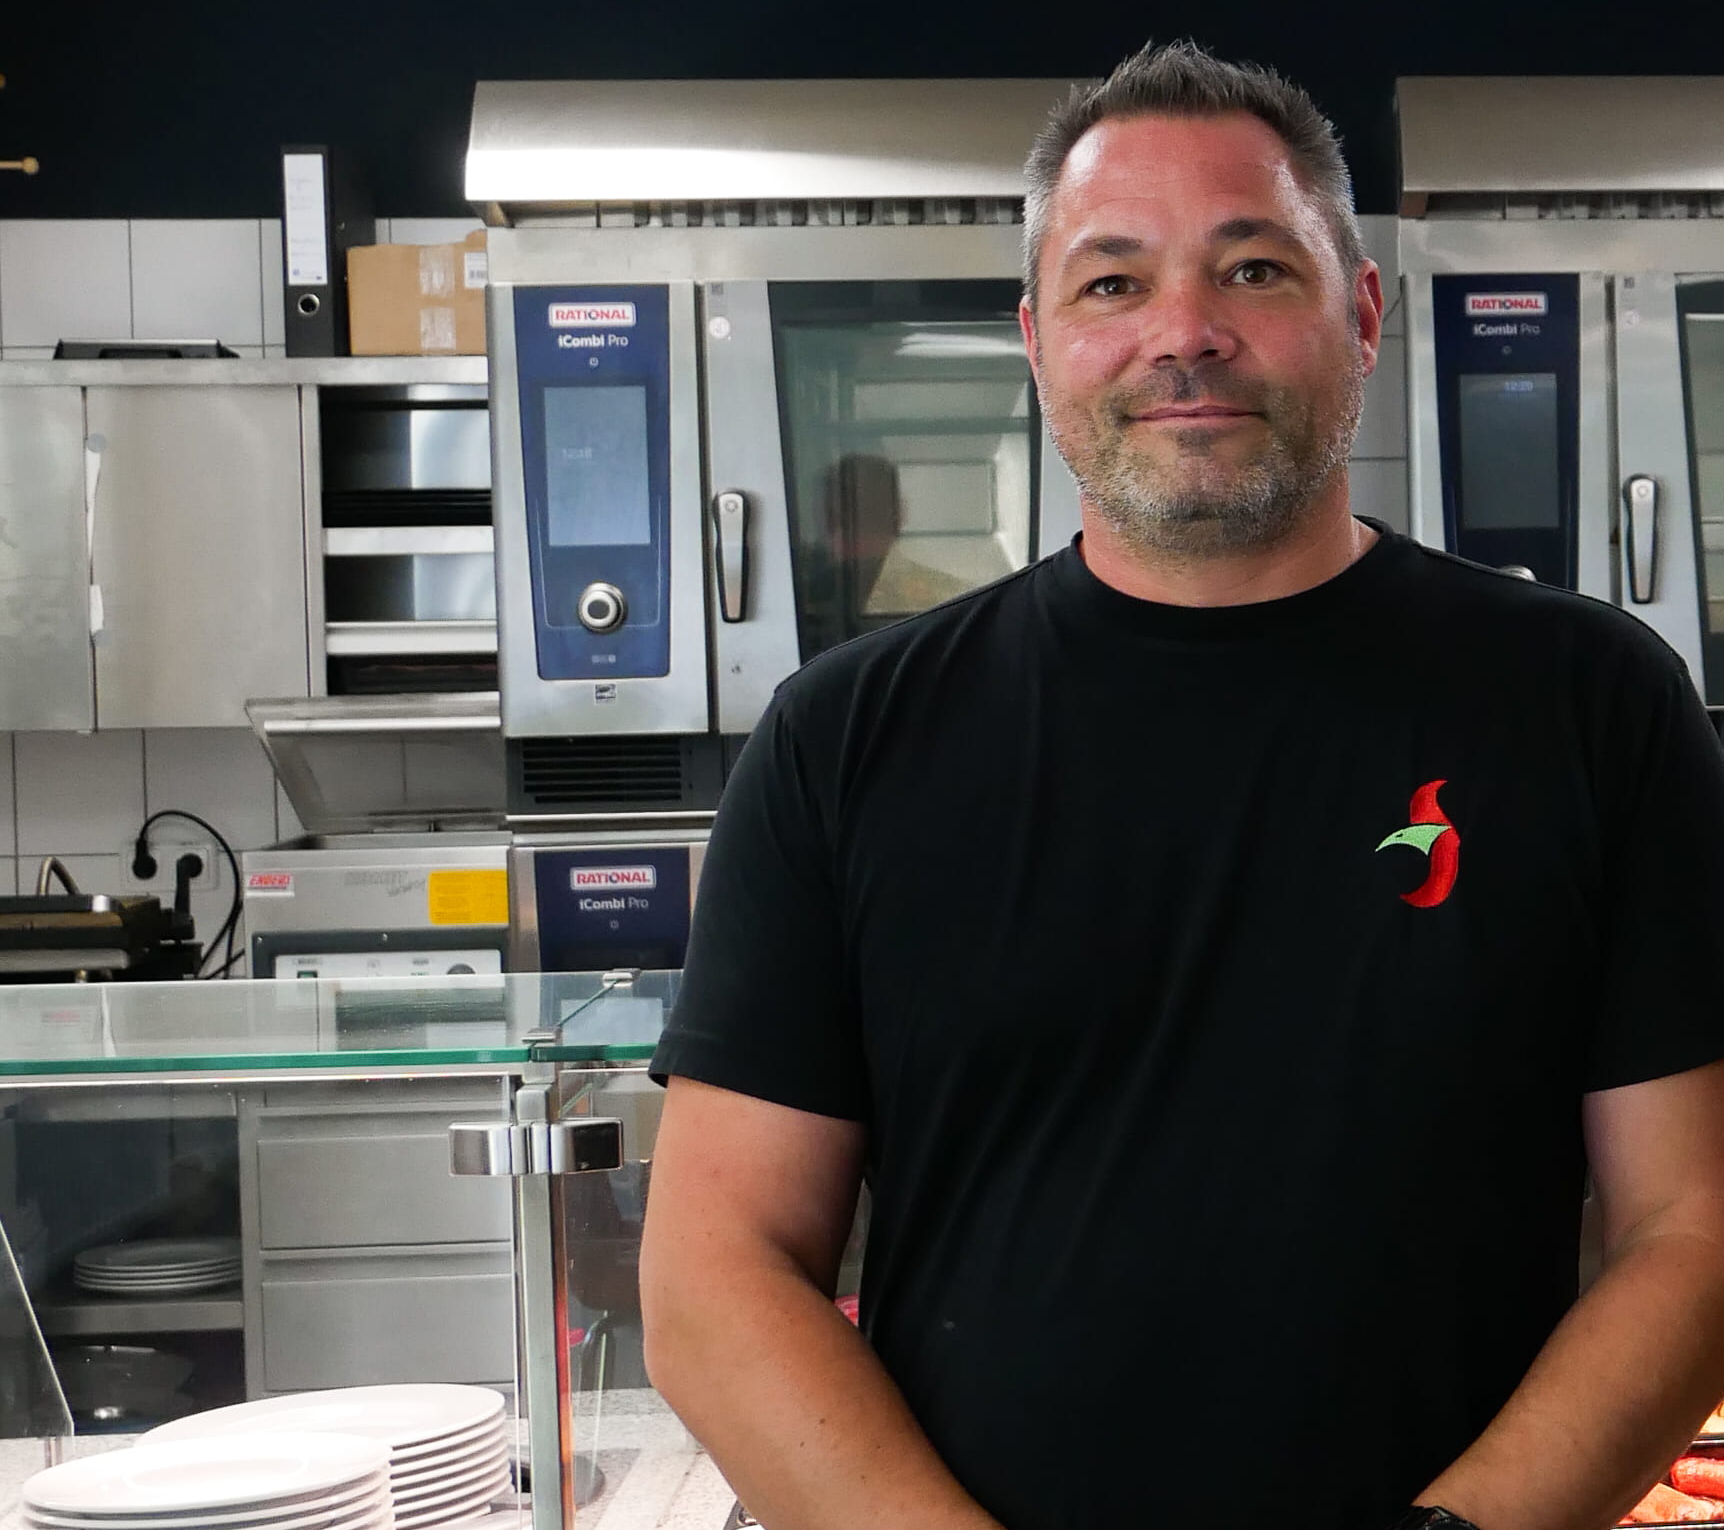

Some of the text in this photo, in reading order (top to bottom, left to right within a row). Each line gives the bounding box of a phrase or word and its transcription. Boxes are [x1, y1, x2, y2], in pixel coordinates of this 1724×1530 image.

[1471, 298, 1543, 310] RATIONAL
[555, 308, 629, 320] RATIONAL
[1473, 324, 1540, 336] iCombi Pro
[559, 335, 628, 348] iCombi Pro
[575, 872, 651, 885] RATIONAL
[579, 898, 648, 910] iCombi Pro
